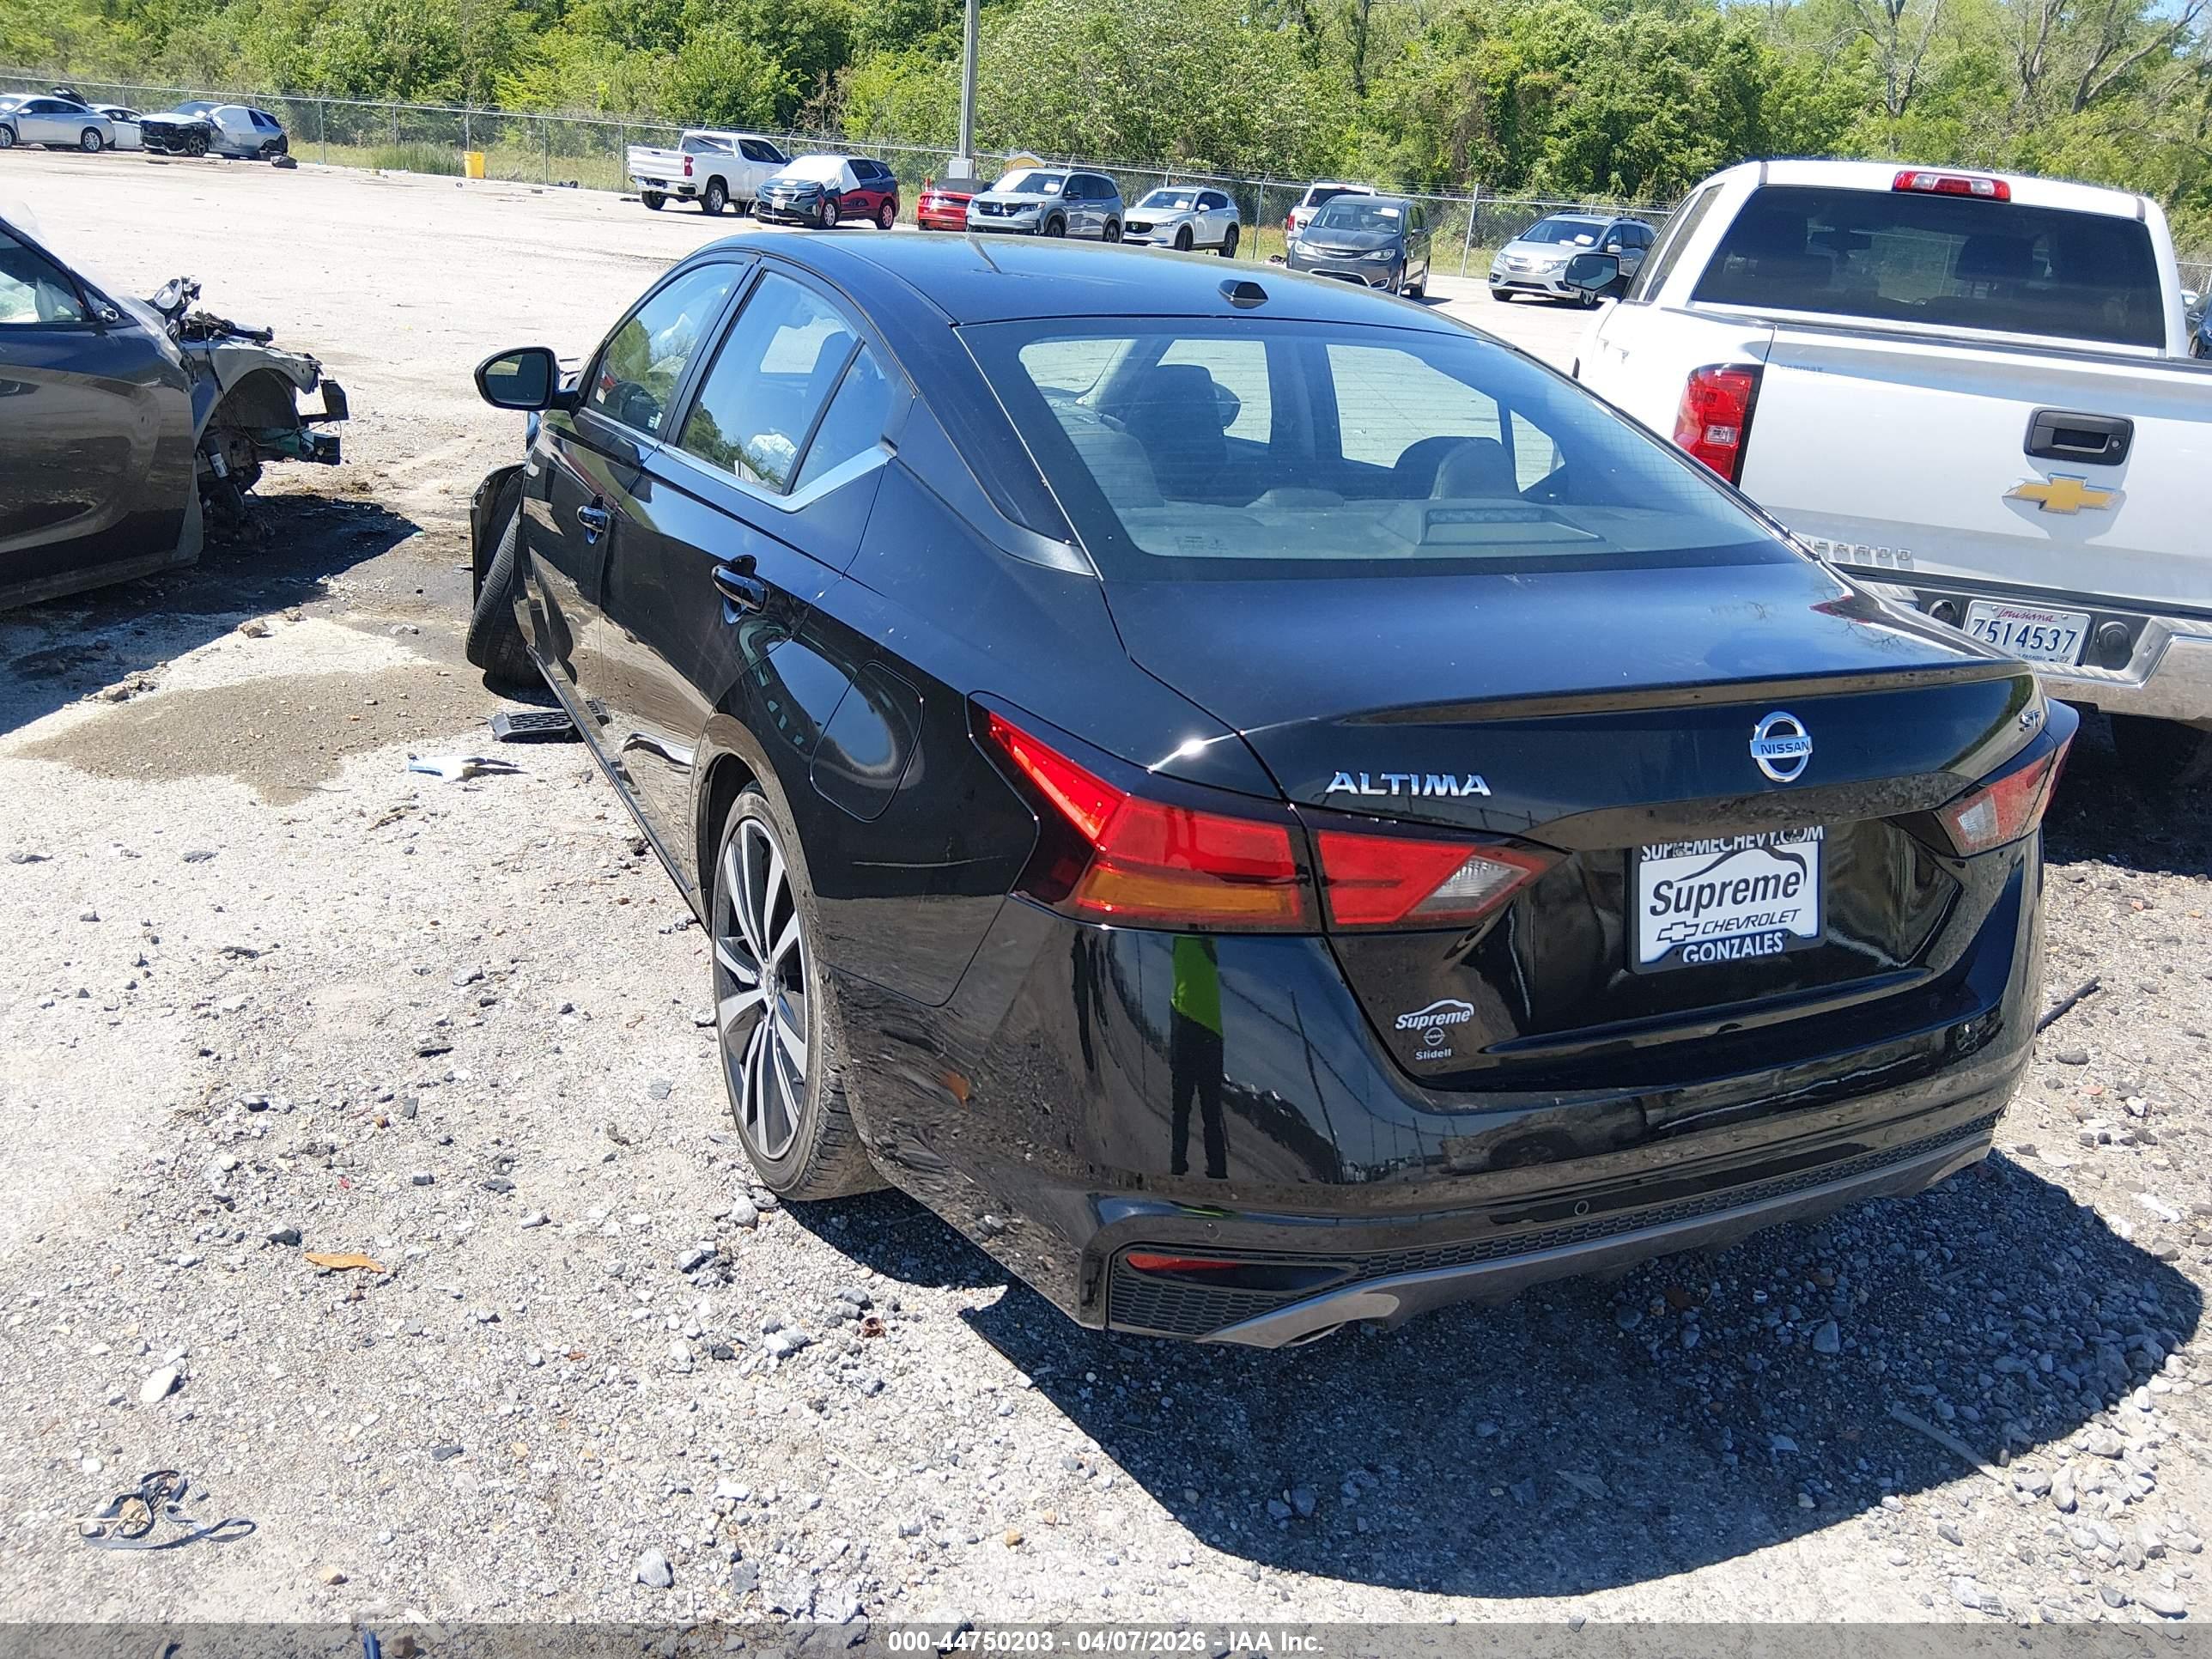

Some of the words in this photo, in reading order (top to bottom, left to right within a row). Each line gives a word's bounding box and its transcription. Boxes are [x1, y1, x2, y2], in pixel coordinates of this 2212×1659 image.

[1997, 607, 2058, 623] Louisiana
[1971, 617, 2078, 653] 7514537
[1760, 741, 1810, 756] NISSAN
[1325, 771, 1492, 797] ALTIMA
[1650, 870, 1802, 919] Supreme
[1701, 908, 1802, 935] CHEVROLET
[1682, 932, 1784, 963] GONZALES
[1395, 1009, 1471, 1031] Supreme
[1415, 1048, 1452, 1060] Slidell
